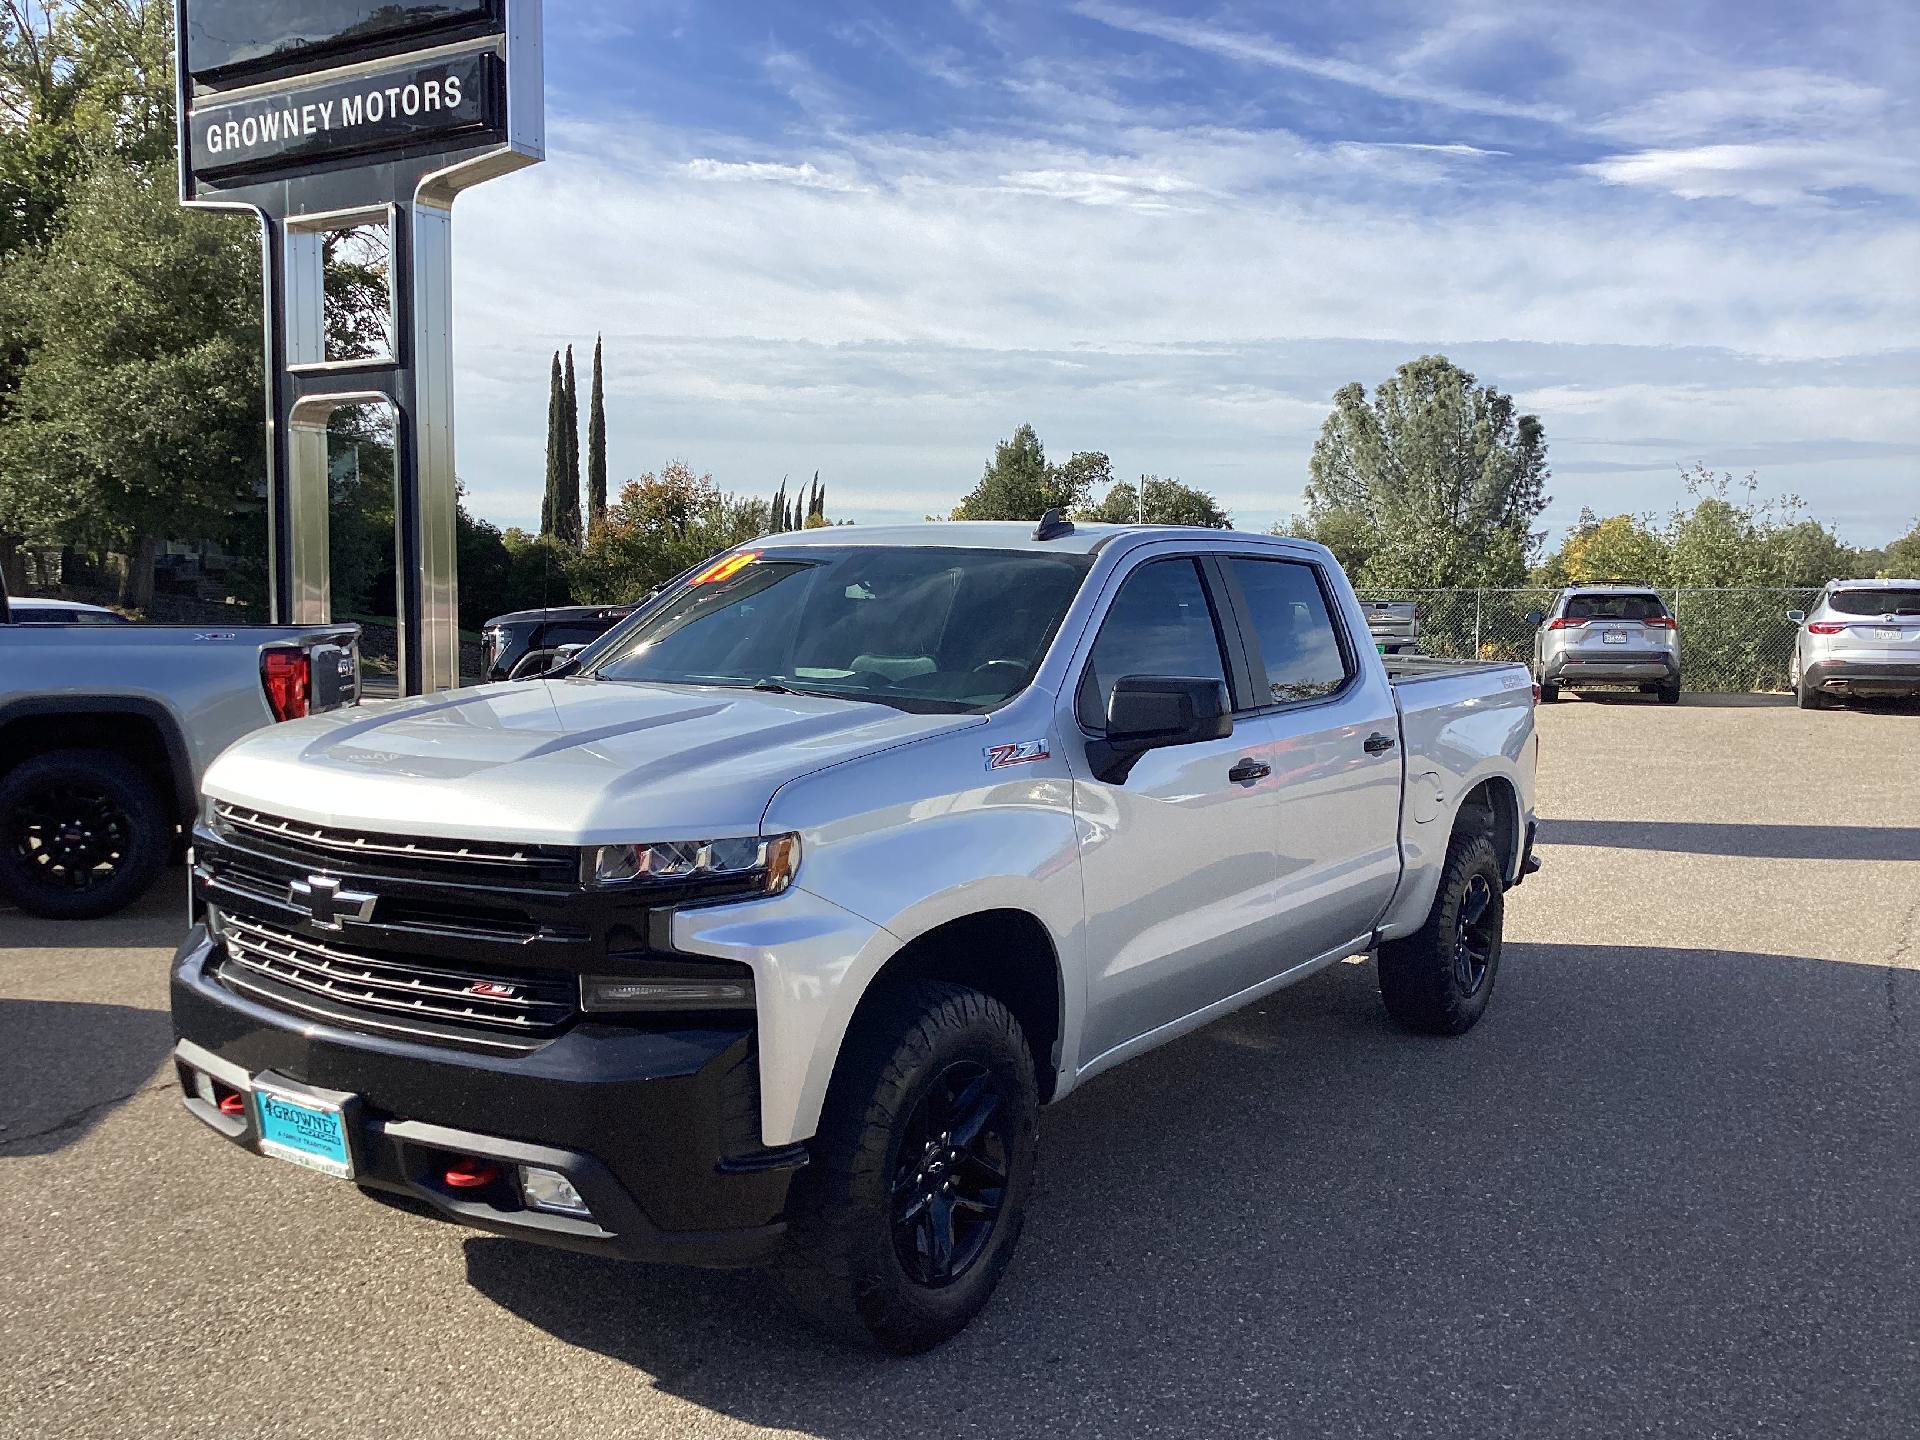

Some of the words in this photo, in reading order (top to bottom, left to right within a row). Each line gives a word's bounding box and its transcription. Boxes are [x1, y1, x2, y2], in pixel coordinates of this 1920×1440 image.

[206, 100, 334, 153] GROWNEY
[341, 75, 462, 127] MOTORS
[984, 738, 1050, 771] Z71
[273, 1104, 337, 1136] GROWNEY
